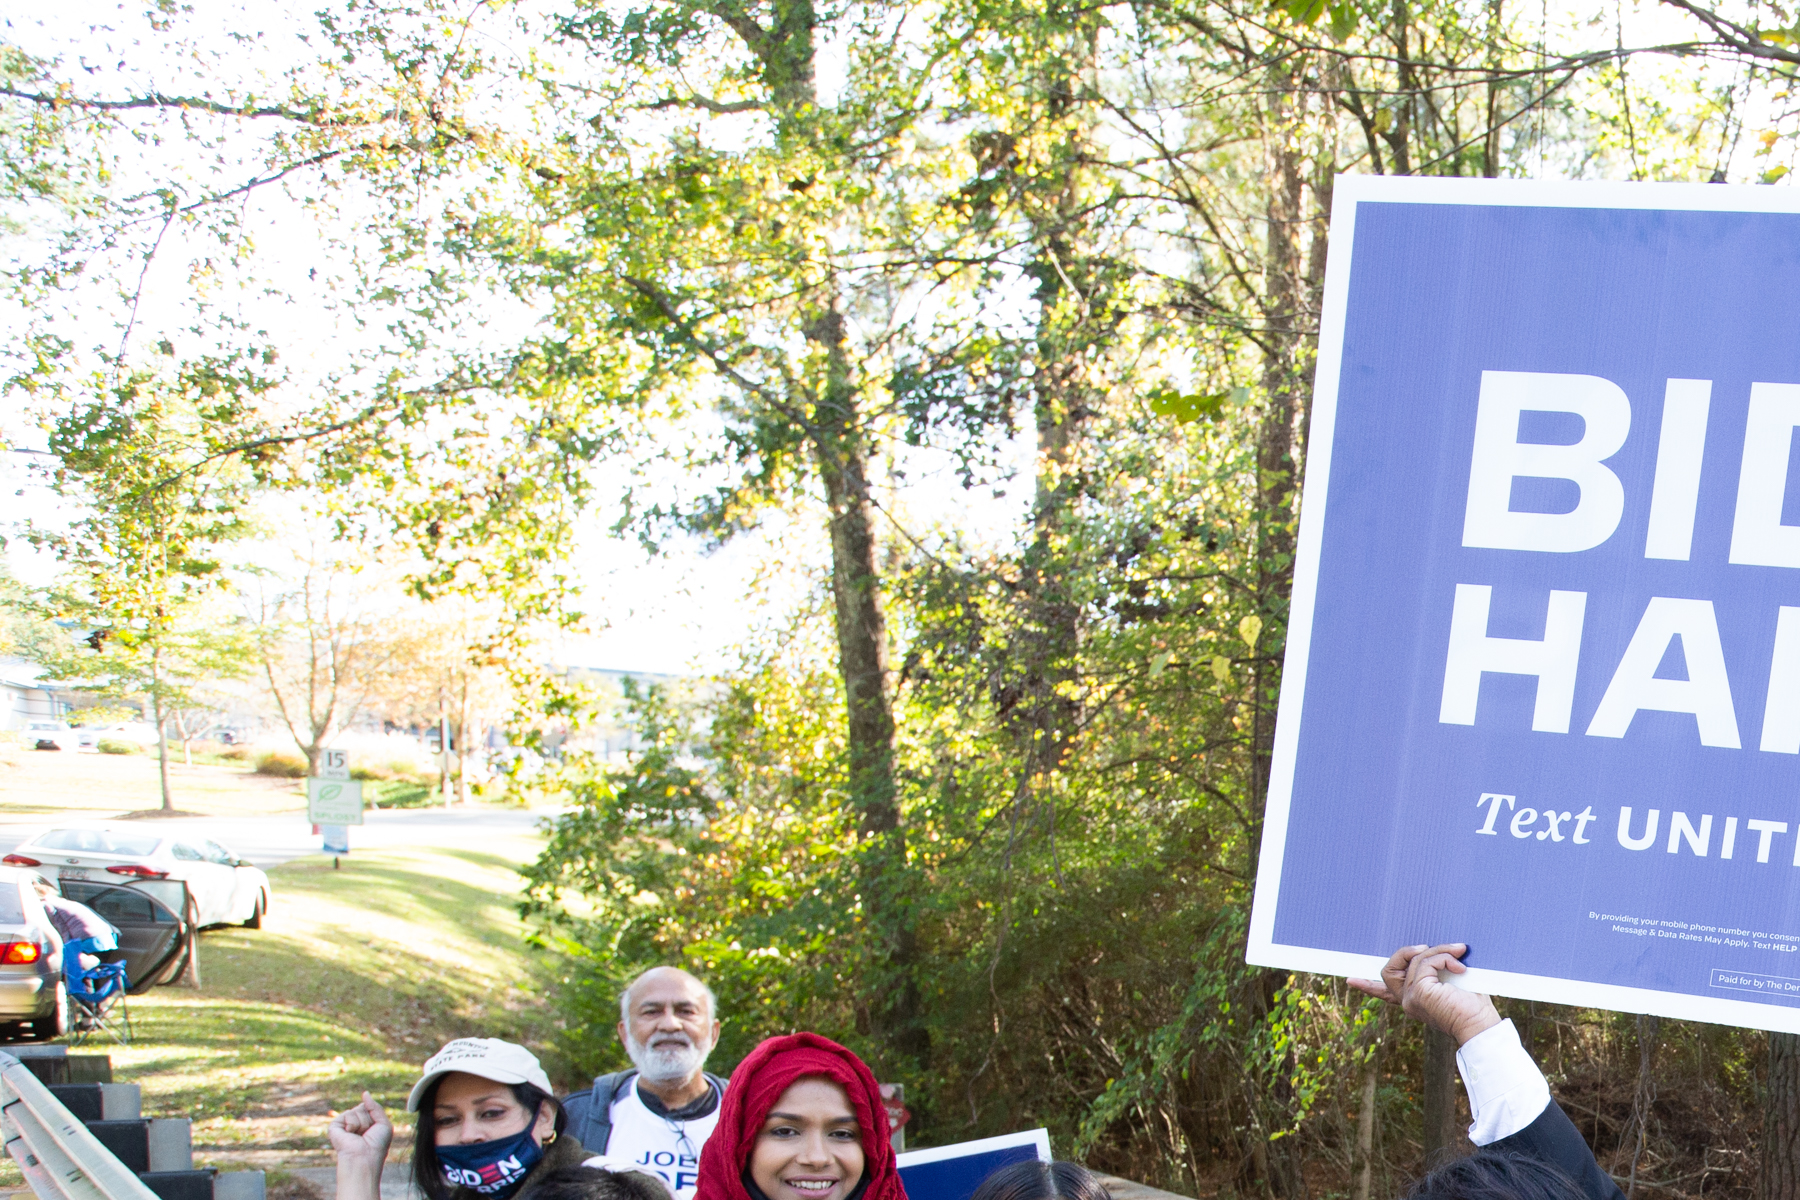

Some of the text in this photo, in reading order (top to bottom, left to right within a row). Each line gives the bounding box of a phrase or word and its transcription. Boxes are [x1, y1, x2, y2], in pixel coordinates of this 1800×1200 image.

[328, 752, 344, 768] 15
[1475, 792, 1597, 845] Text
[1588, 910, 1601, 921] By
[1600, 913, 1639, 925] providing
[1639, 917, 1659, 926] your
[1659, 919, 1689, 930] mobile
[1689, 922, 1717, 933] phone
[1717, 926, 1751, 937] number
[1751, 930, 1768, 939] you
[1611, 924, 1648, 937] Message
[1648, 928, 1656, 937] &
[1657, 929, 1678, 939] Data
[1678, 931, 1703, 942] Rates
[1703, 934, 1723, 945] May
[1722, 937, 1750, 949] Apply.
[1752, 940, 1771, 950] Text
[1771, 942, 1798, 953] HELP
[1717, 973, 1739, 984] Paid
[1739, 976, 1752, 986] for
[1752, 977, 1765, 989] by
[1765, 979, 1783, 990] The
[636, 1151, 697, 1168] JOE
